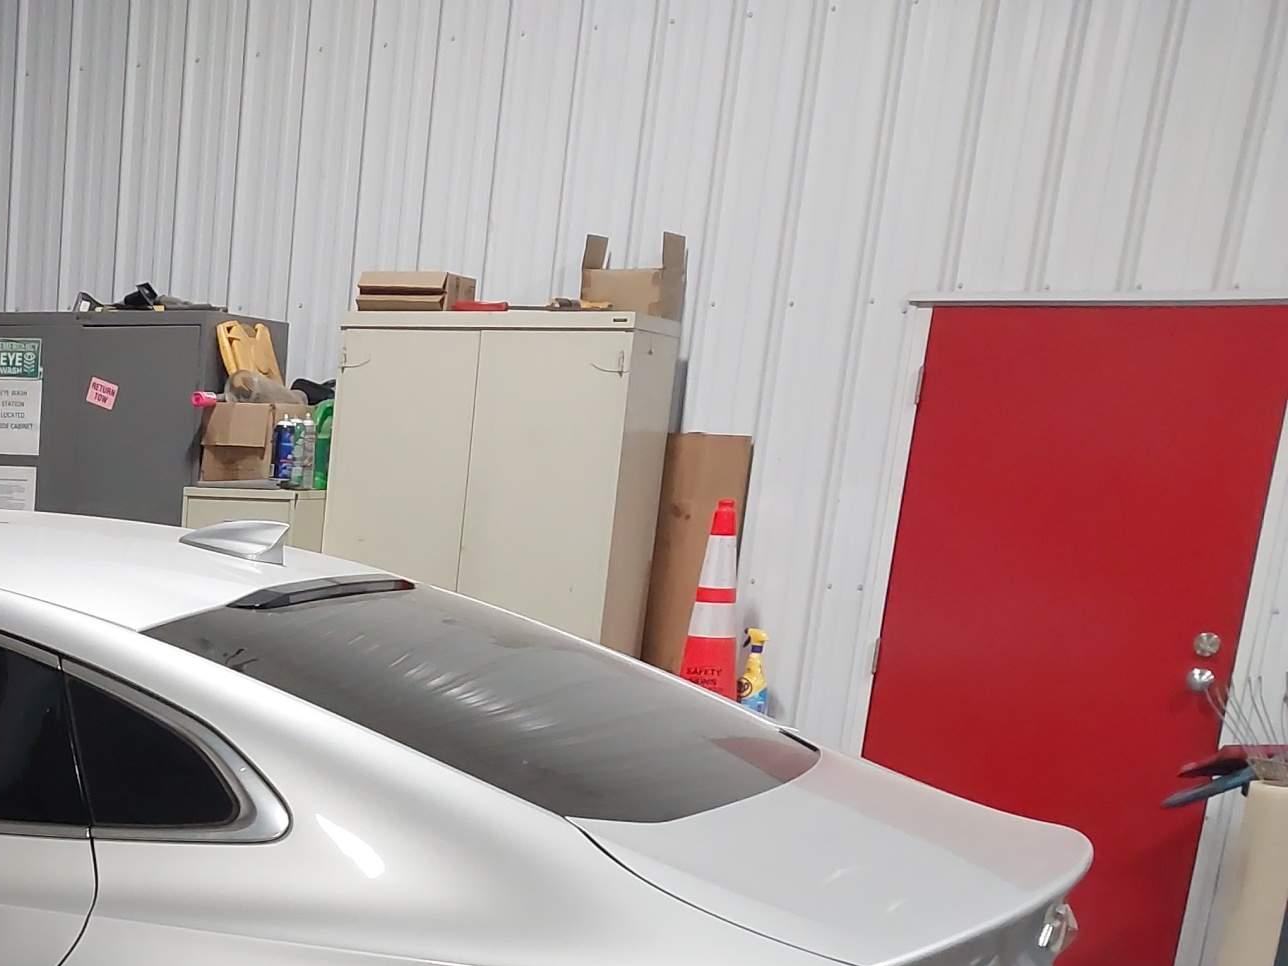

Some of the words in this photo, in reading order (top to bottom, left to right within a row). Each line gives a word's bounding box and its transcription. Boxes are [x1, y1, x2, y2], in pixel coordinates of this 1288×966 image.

[0, 352, 23, 366] EYE
[0, 366, 23, 374] WASH
[92, 382, 115, 396] RETURN
[94, 392, 108, 403] TOW
